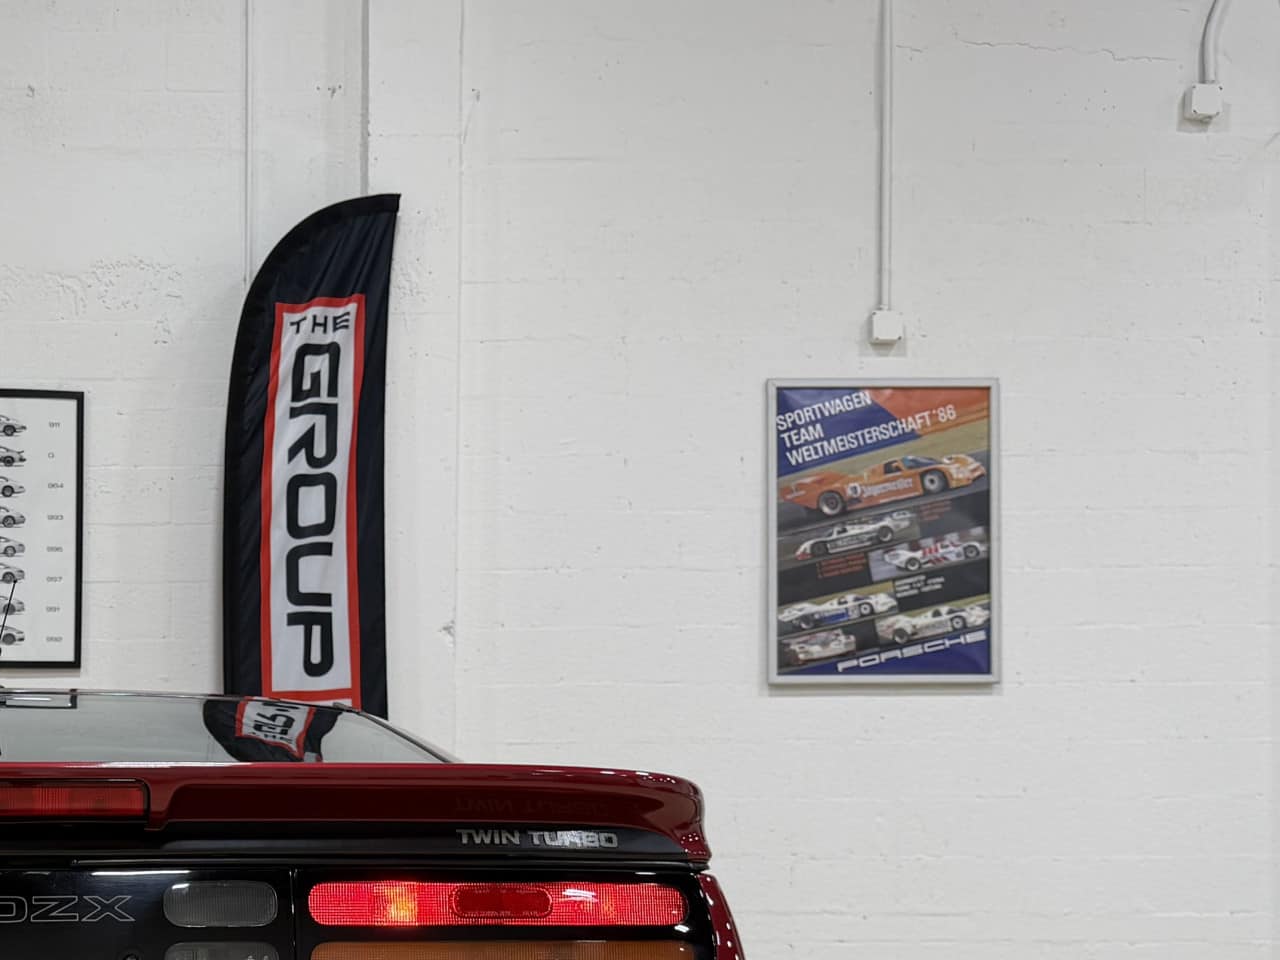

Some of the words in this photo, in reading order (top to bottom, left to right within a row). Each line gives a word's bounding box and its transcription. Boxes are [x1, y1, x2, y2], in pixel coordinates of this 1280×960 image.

[289, 310, 351, 335] THE
[776, 390, 873, 431] SPORTWAGEN
[780, 424, 824, 449] TEAM
[786, 410, 932, 466] WELTMEISTERSCHAFT
[285, 341, 341, 678] GROUP
[837, 630, 987, 672] PORSCHE
[456, 829, 520, 845] TWIN
[527, 830, 618, 848] TURBO
